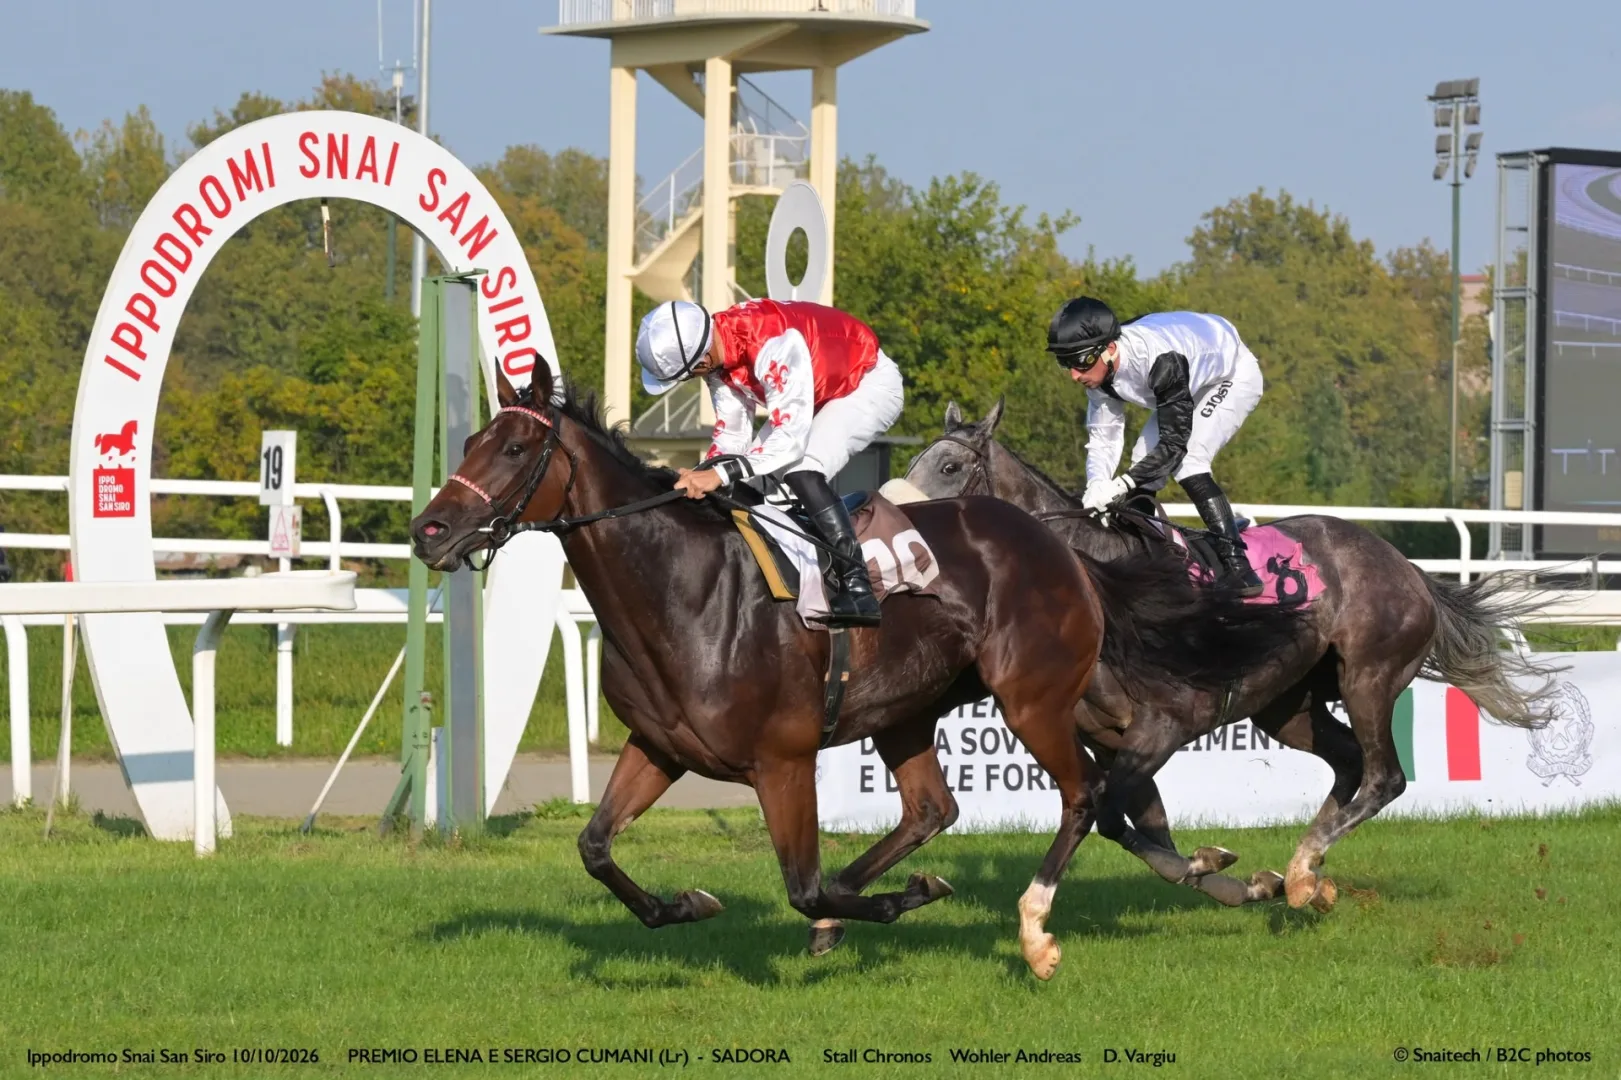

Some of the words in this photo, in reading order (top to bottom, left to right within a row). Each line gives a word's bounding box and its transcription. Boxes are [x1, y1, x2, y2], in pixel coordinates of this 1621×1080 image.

[104, 142, 276, 381] IPPODROMI
[298, 131, 400, 187] SNAI
[418, 167, 499, 261] SAN
[480, 266, 538, 377] SIRO
[264, 445, 283, 490] 19
[98, 475, 116, 485] IPPO
[98, 484, 124, 494] DROMO
[98, 493, 116, 503] SNAI
[98, 502, 114, 512] SAN
[114, 502, 131, 512] SIRO
[861, 529, 940, 593] 10
[859, 765, 875, 793] E
